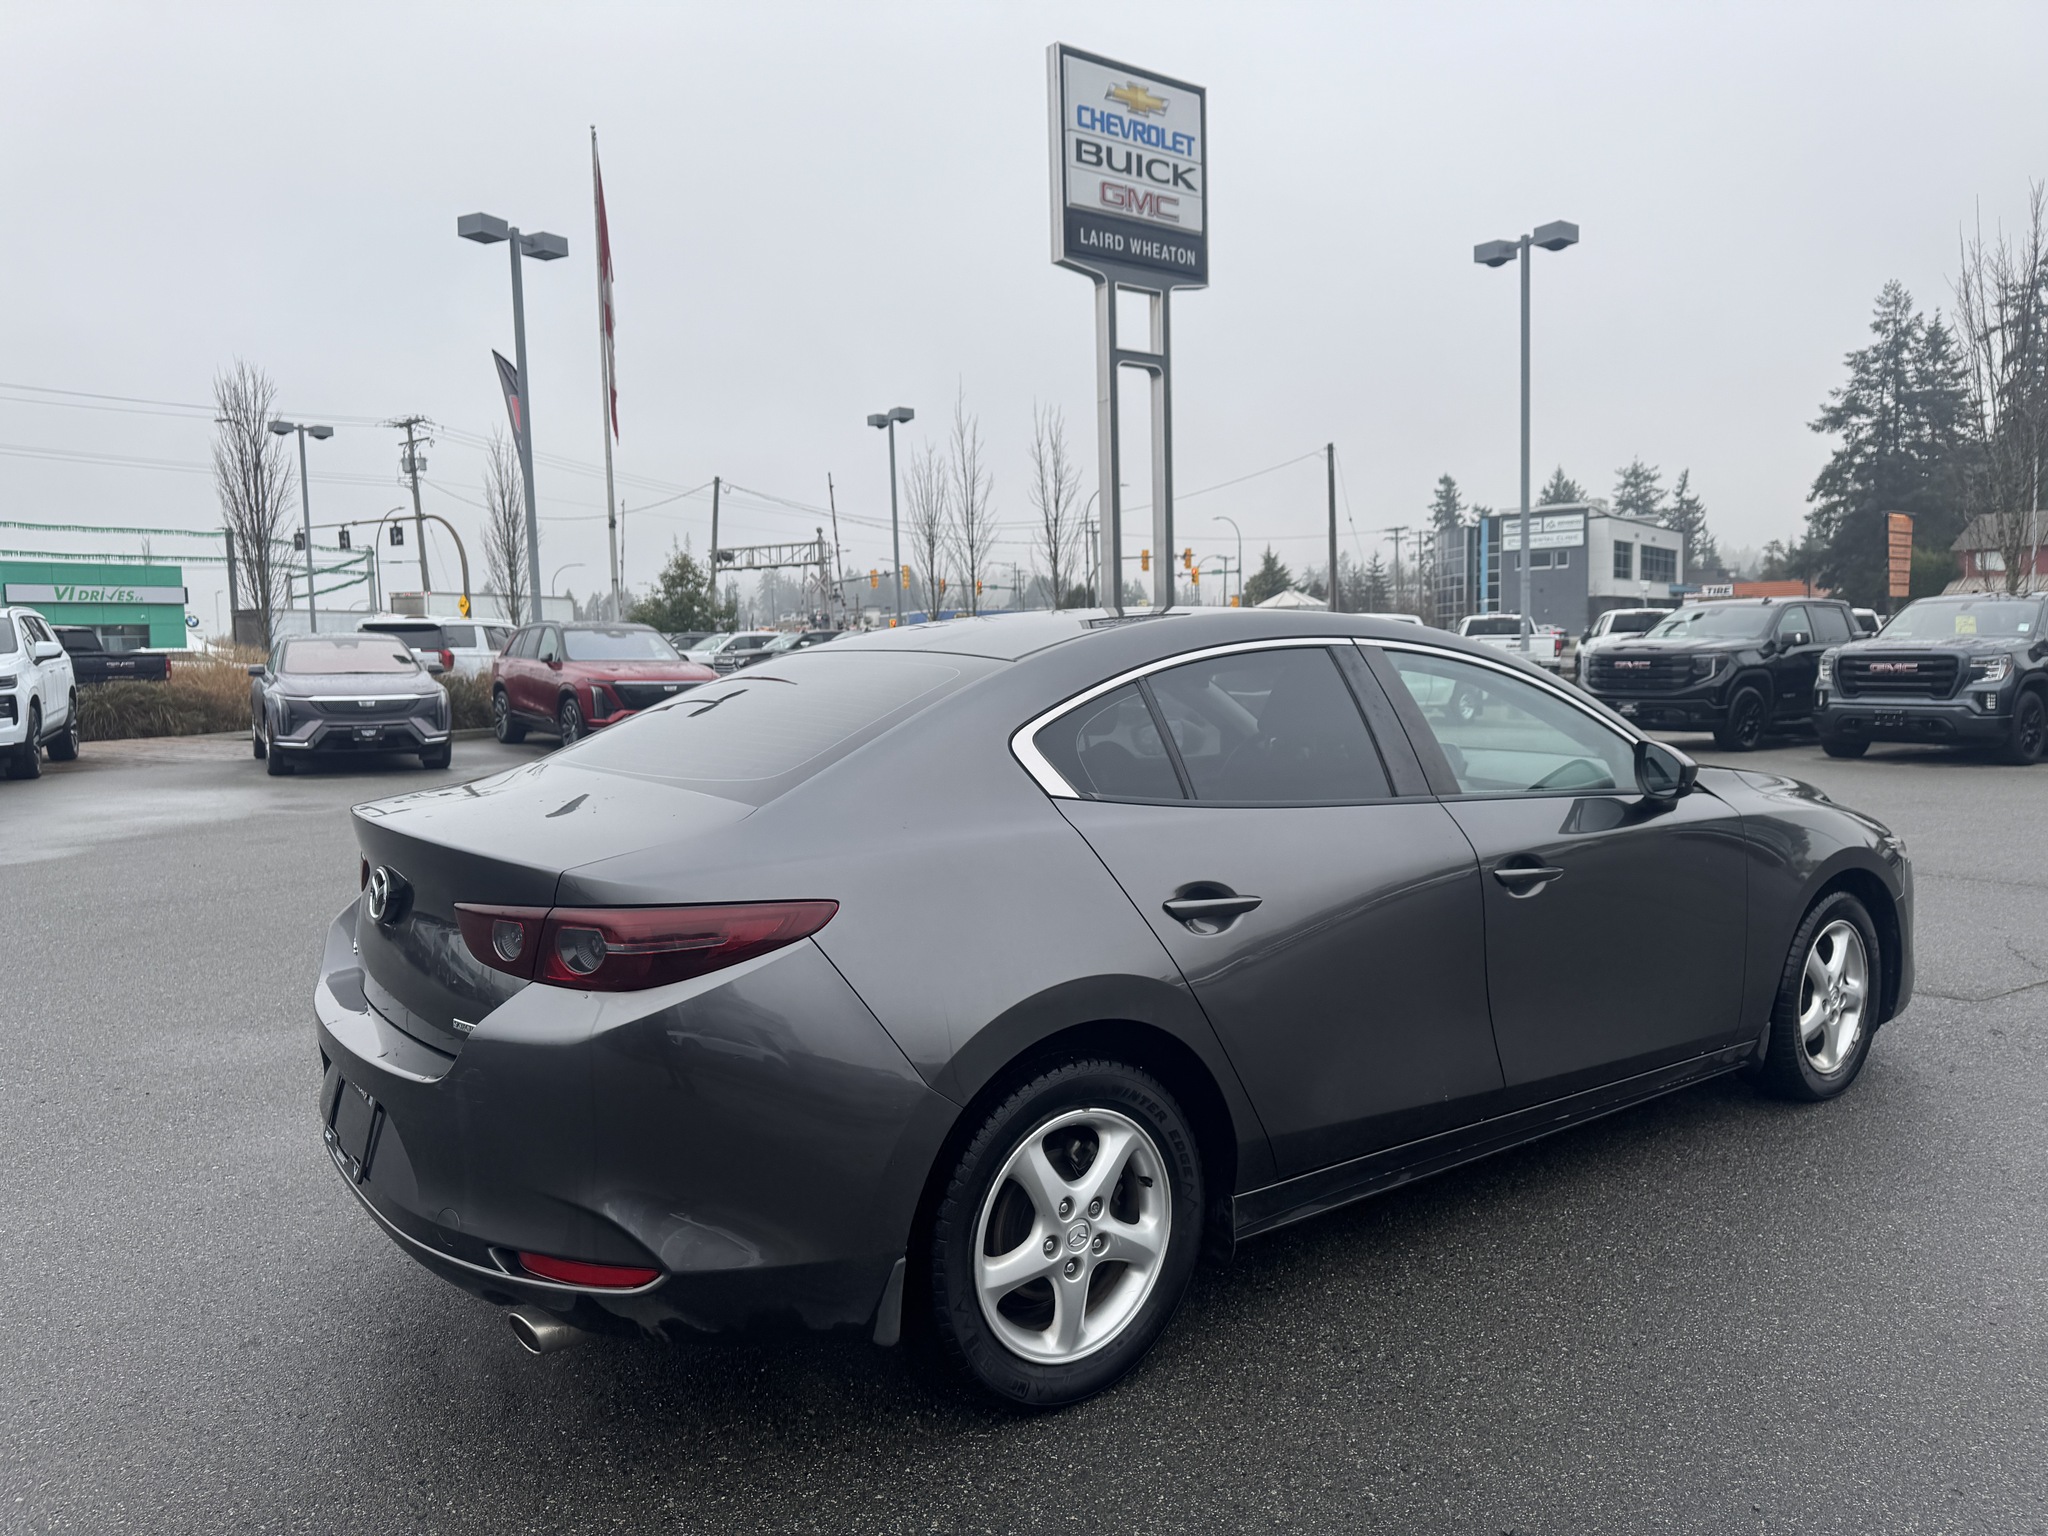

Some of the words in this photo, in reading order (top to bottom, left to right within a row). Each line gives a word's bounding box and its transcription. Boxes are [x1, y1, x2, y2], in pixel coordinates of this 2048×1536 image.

[1077, 104, 1195, 157] CHEVROLET
[1075, 138, 1198, 191] BUICK
[1099, 180, 1180, 222] GMC
[1080, 227, 1124, 252] LAIRD
[1129, 238, 1196, 266] WHEATON
[54, 586, 75, 601] VI
[1707, 585, 1732, 594] TIRE
[1869, 662, 1919, 673] GMC
[1110, 1084, 1168, 1123] WINTER
[1168, 1129, 1195, 1179] EDGE
